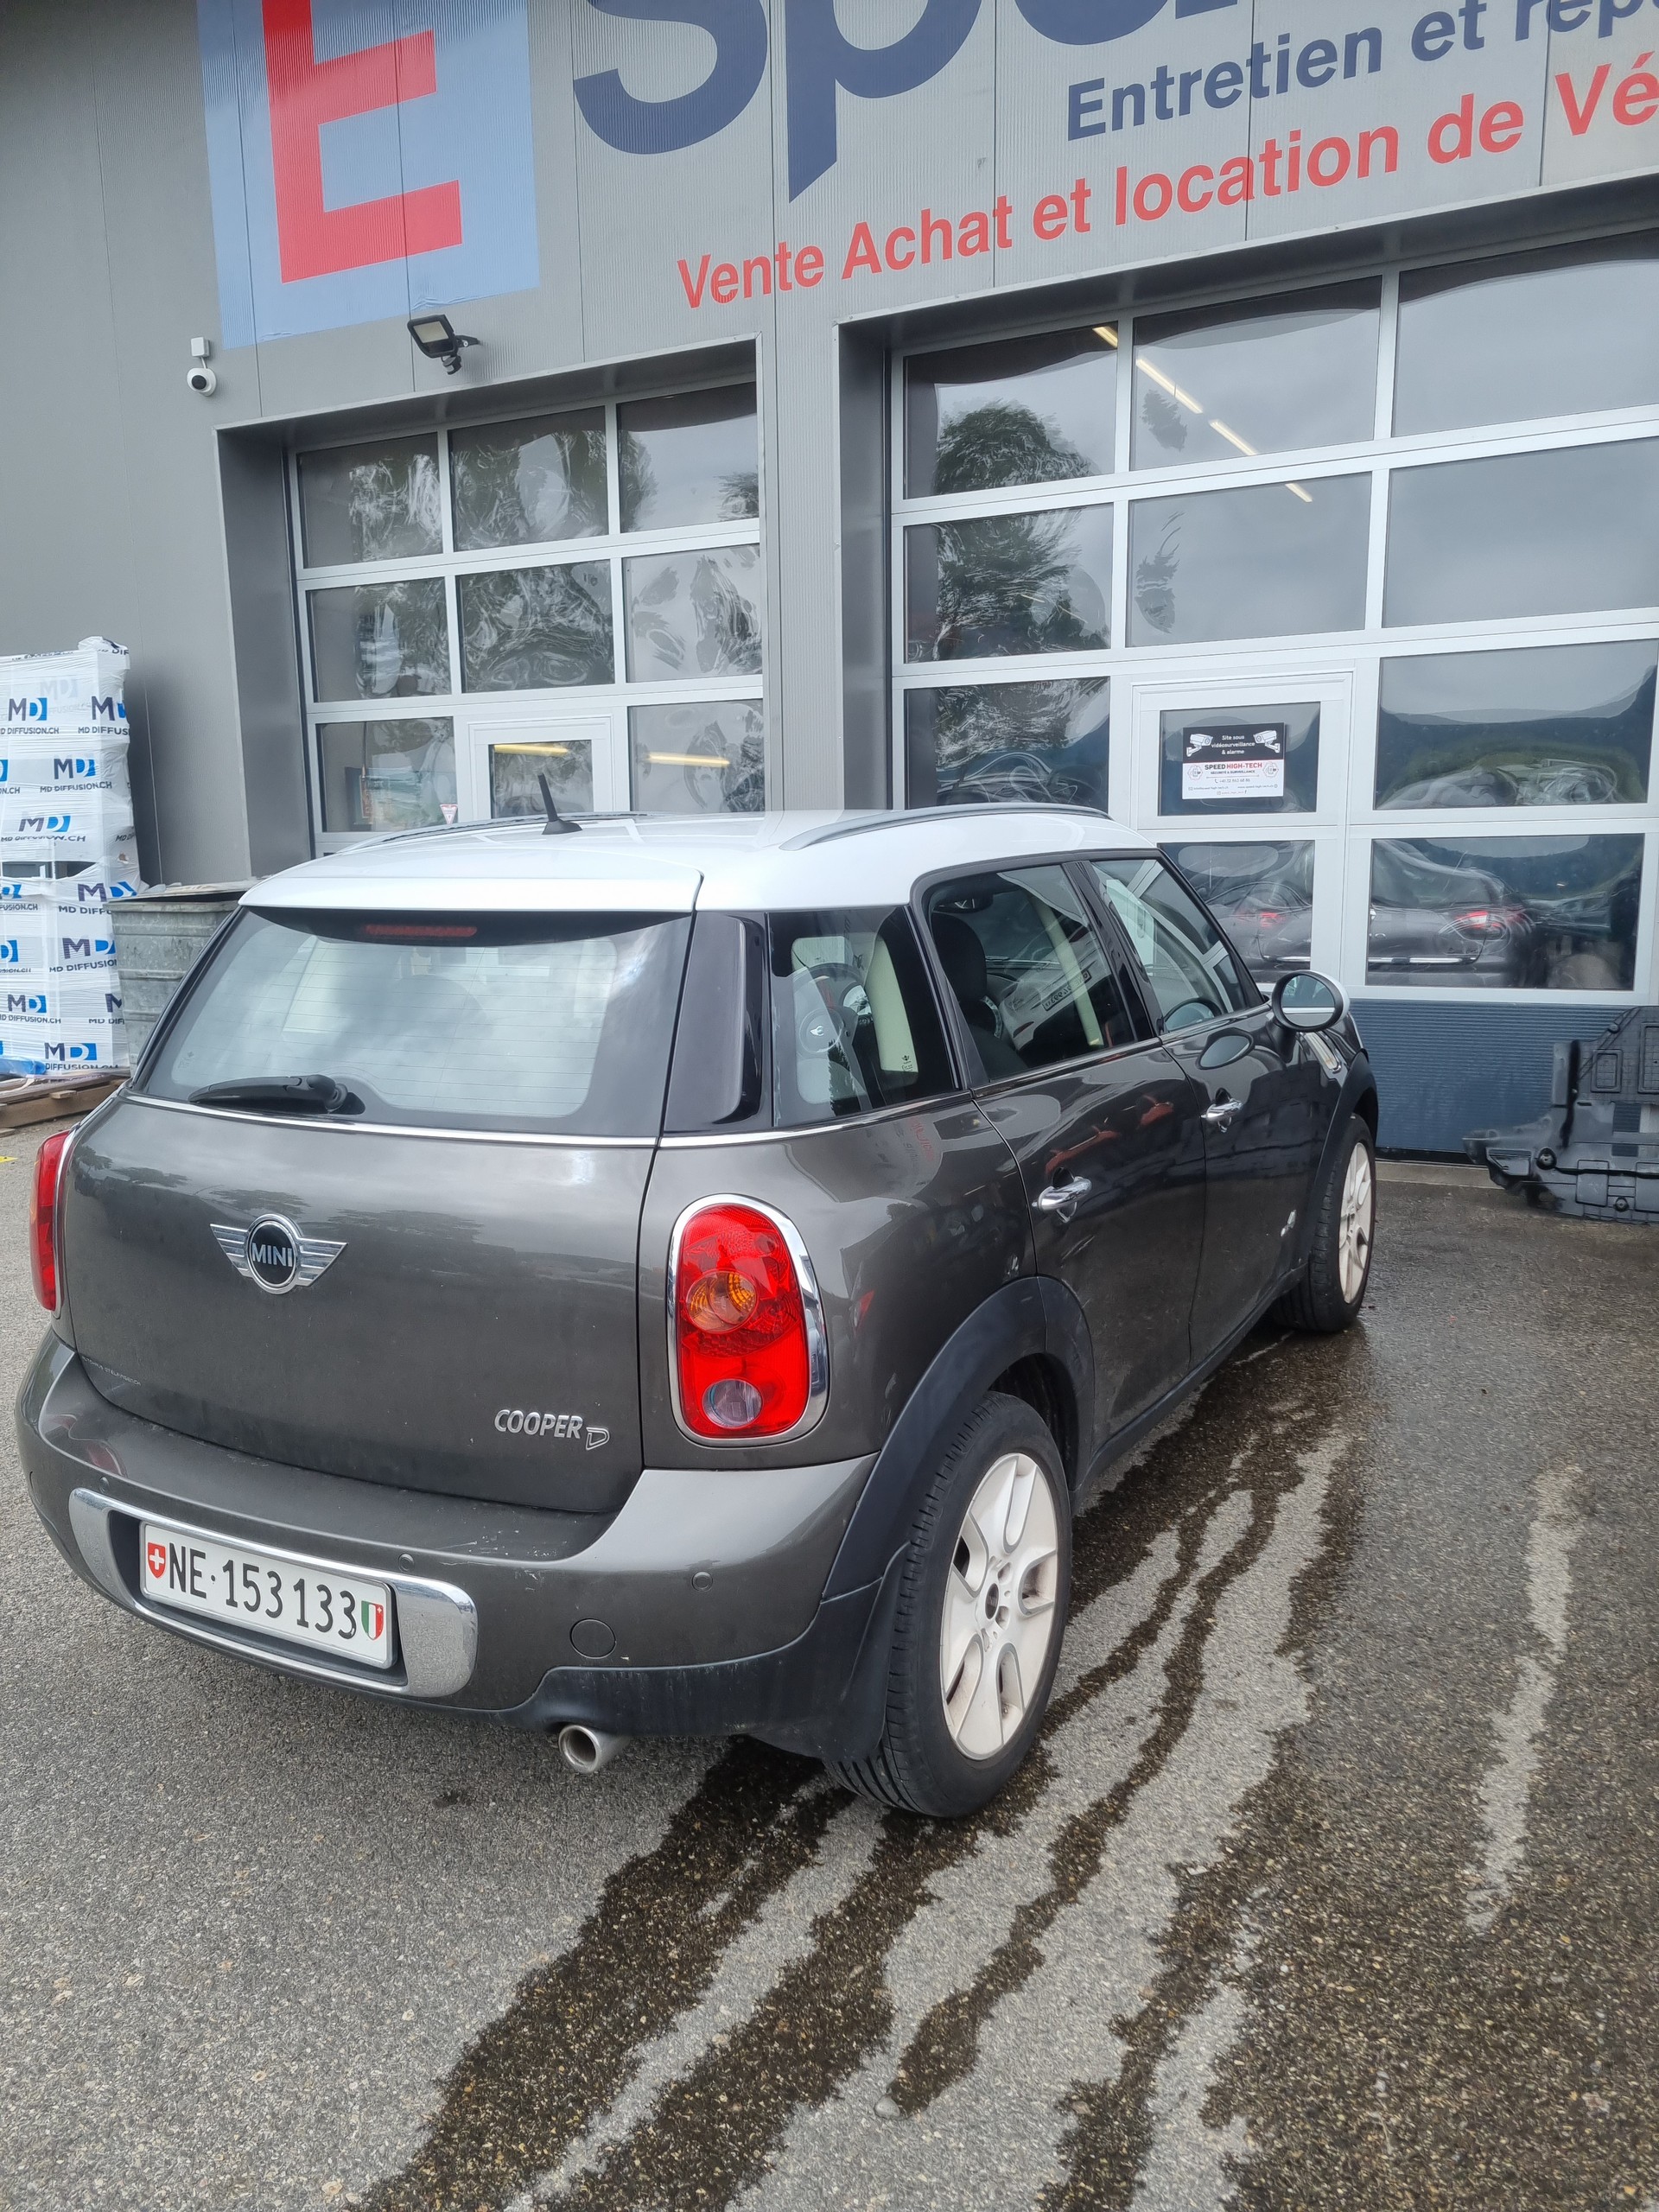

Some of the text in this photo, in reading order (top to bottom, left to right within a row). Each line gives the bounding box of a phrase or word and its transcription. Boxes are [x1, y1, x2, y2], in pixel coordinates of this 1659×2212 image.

[1068, 28, 1382, 140] Entretien
[1411, 0, 1486, 61] et
[677, 51, 1659, 308] Vente Achat et location de Vé
[8, 697, 48, 721] MD
[54, 758, 96, 780] MD
[54, 781, 112, 791] DIFFUSION.CH
[18, 815, 71, 832] MD
[78, 881, 137, 902] MD
[8, 994, 47, 1013] MD
[9, 1015, 61, 1024] DIFFUSION.CH
[44, 1042, 98, 1061] MD
[251, 1243, 293, 1267] MINI
[494, 1409, 610, 1451] COOPER D
